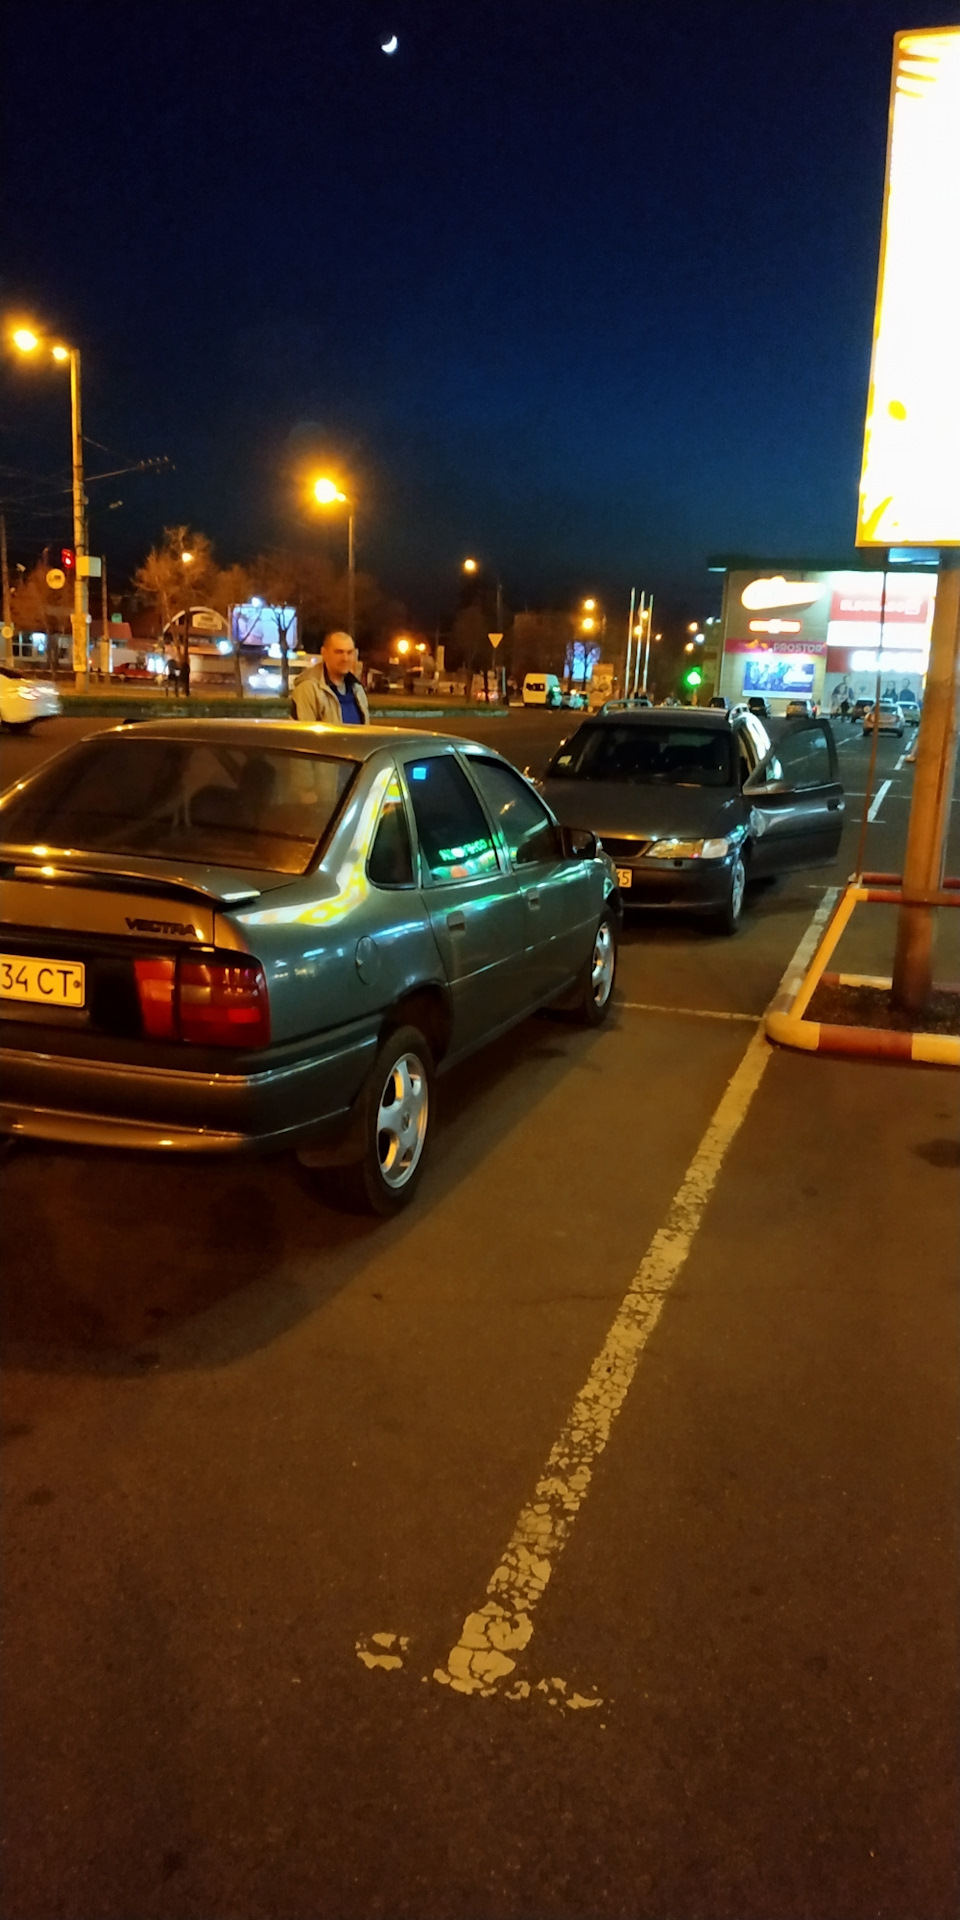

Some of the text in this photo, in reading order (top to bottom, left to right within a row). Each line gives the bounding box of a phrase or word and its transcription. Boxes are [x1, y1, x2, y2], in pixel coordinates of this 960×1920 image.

[773, 643, 823, 653] PROSTOR
[125, 917, 196, 937] VECTRA
[1, 963, 74, 997] 34 CT
